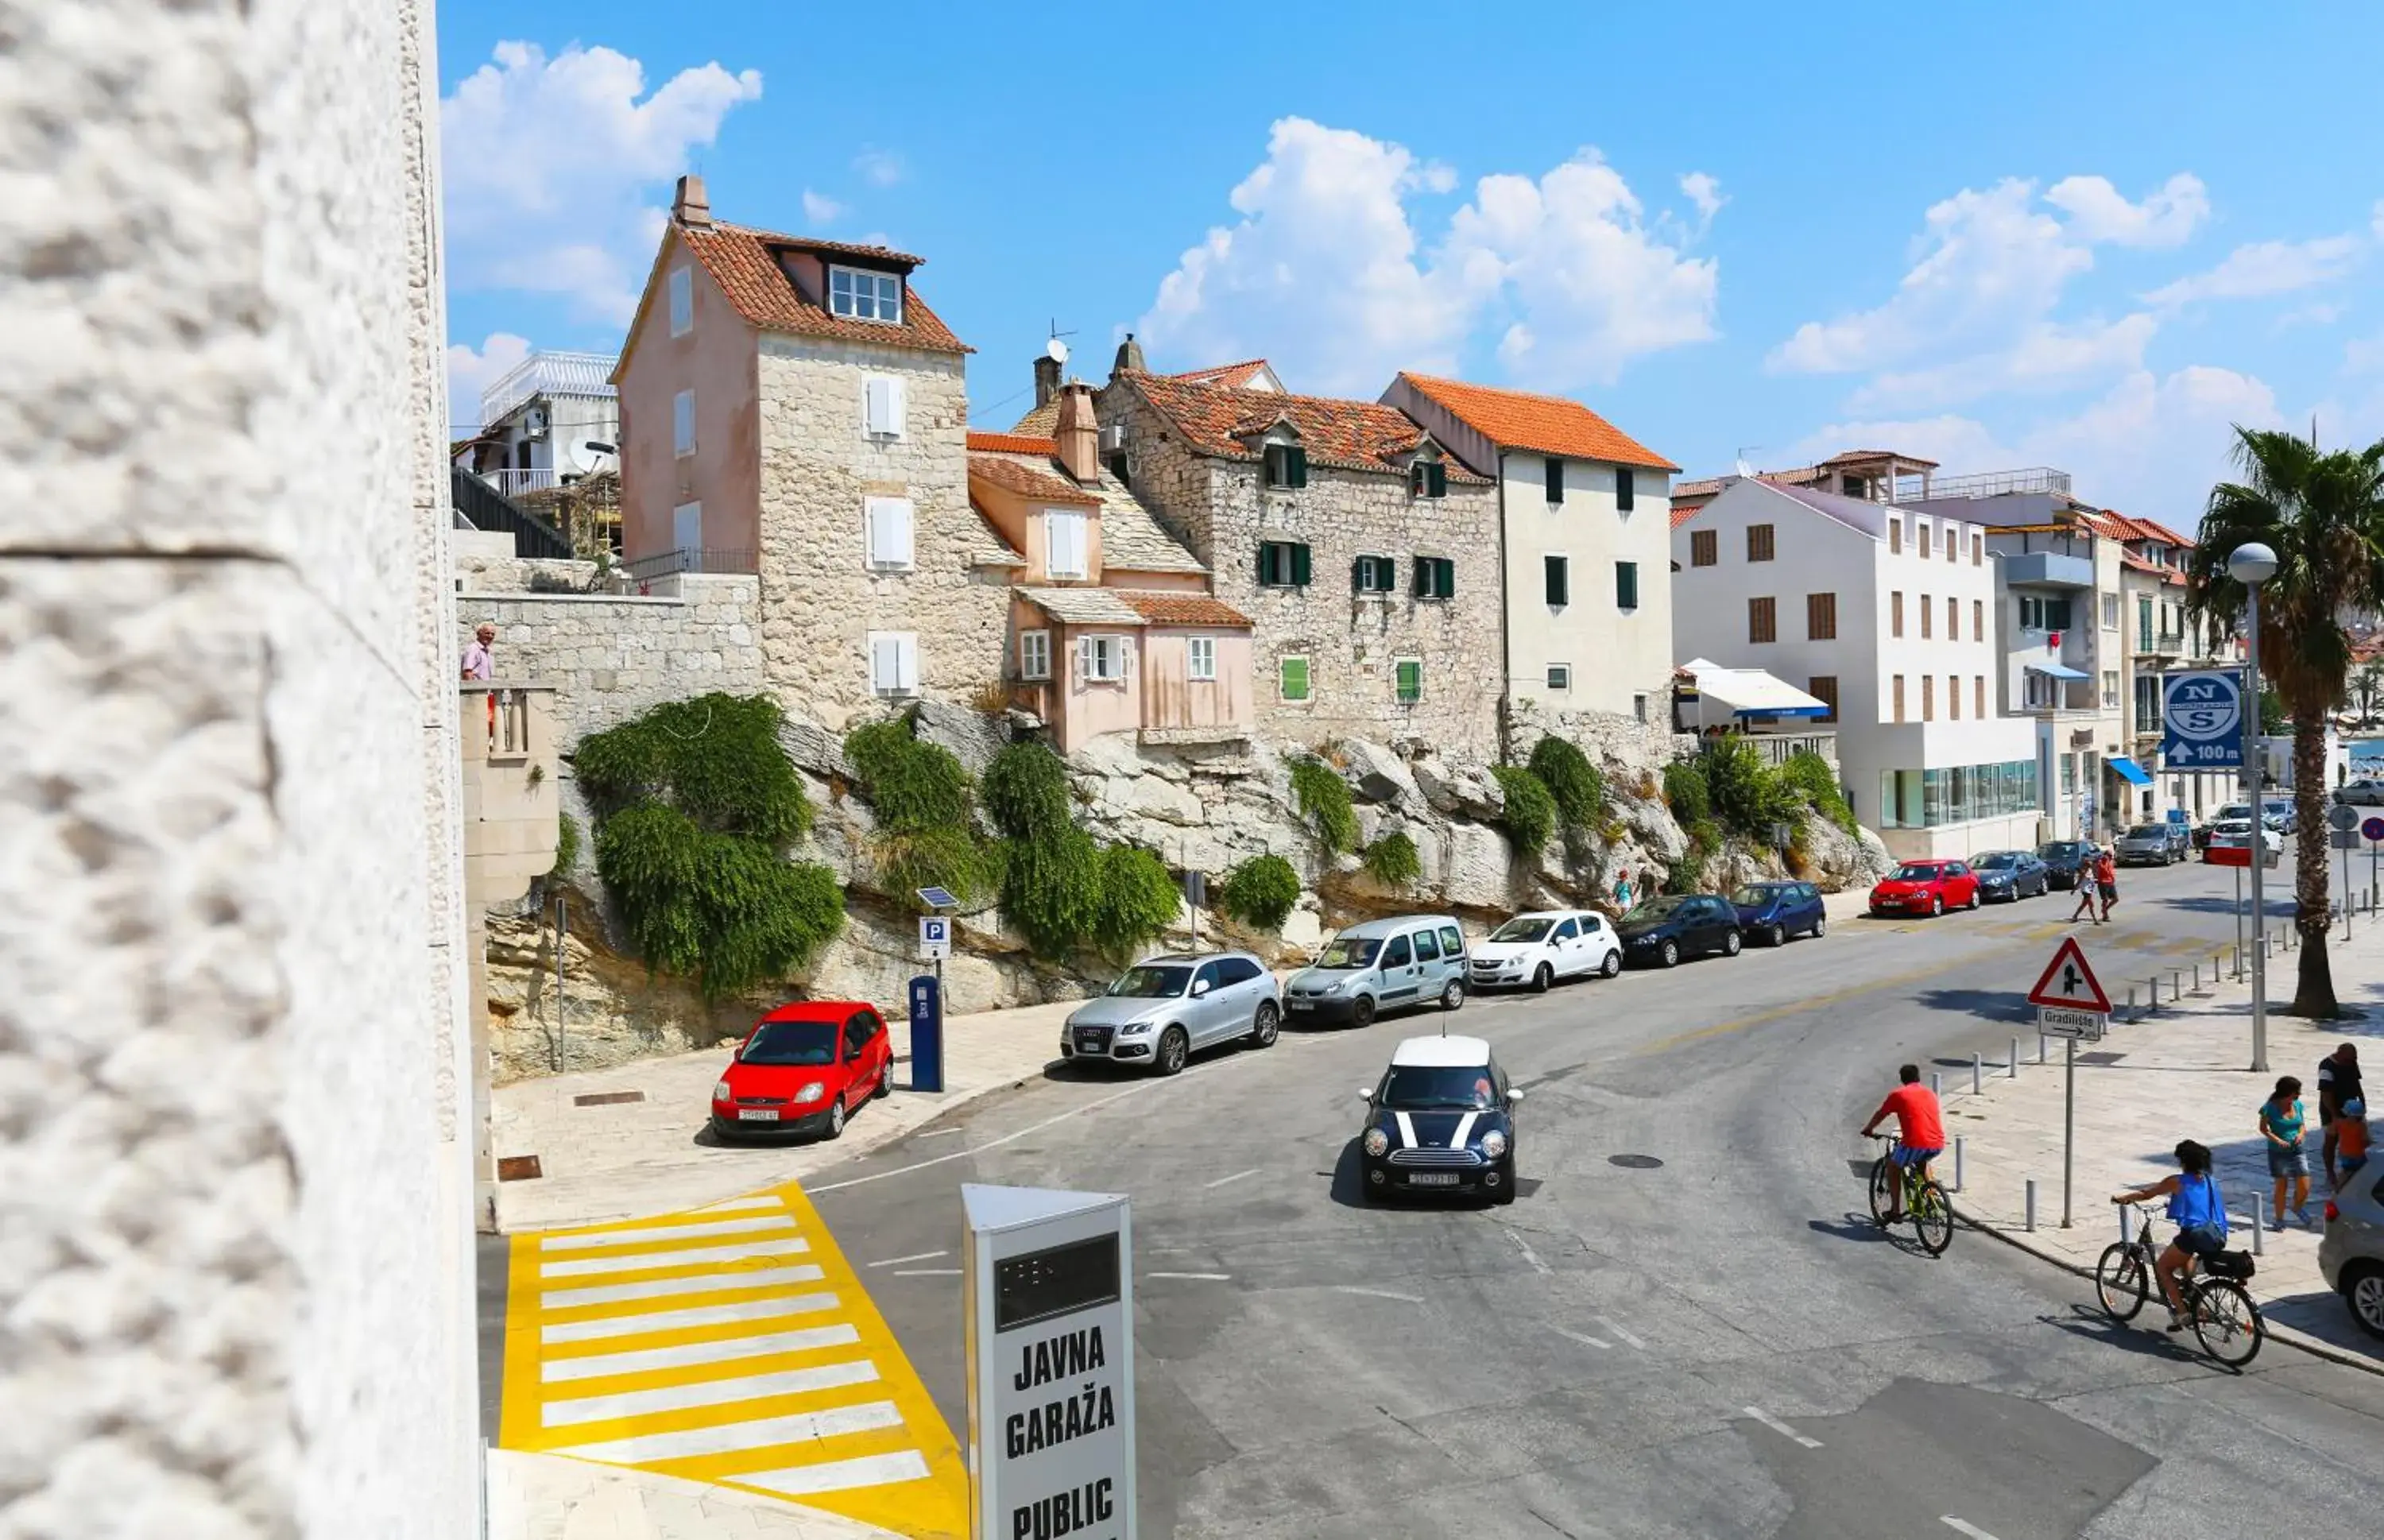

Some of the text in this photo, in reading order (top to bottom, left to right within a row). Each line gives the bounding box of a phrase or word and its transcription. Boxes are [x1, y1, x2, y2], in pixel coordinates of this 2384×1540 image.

[2185, 684, 2216, 700] N
[2189, 711, 2215, 729] S
[2196, 745, 2239, 760] 100 m
[931, 924, 942, 938] P
[1014, 1325, 1105, 1391] JAVNA
[1006, 1382, 1116, 1460] GARAŽA
[1012, 1477, 1113, 1540] PUBLIC
